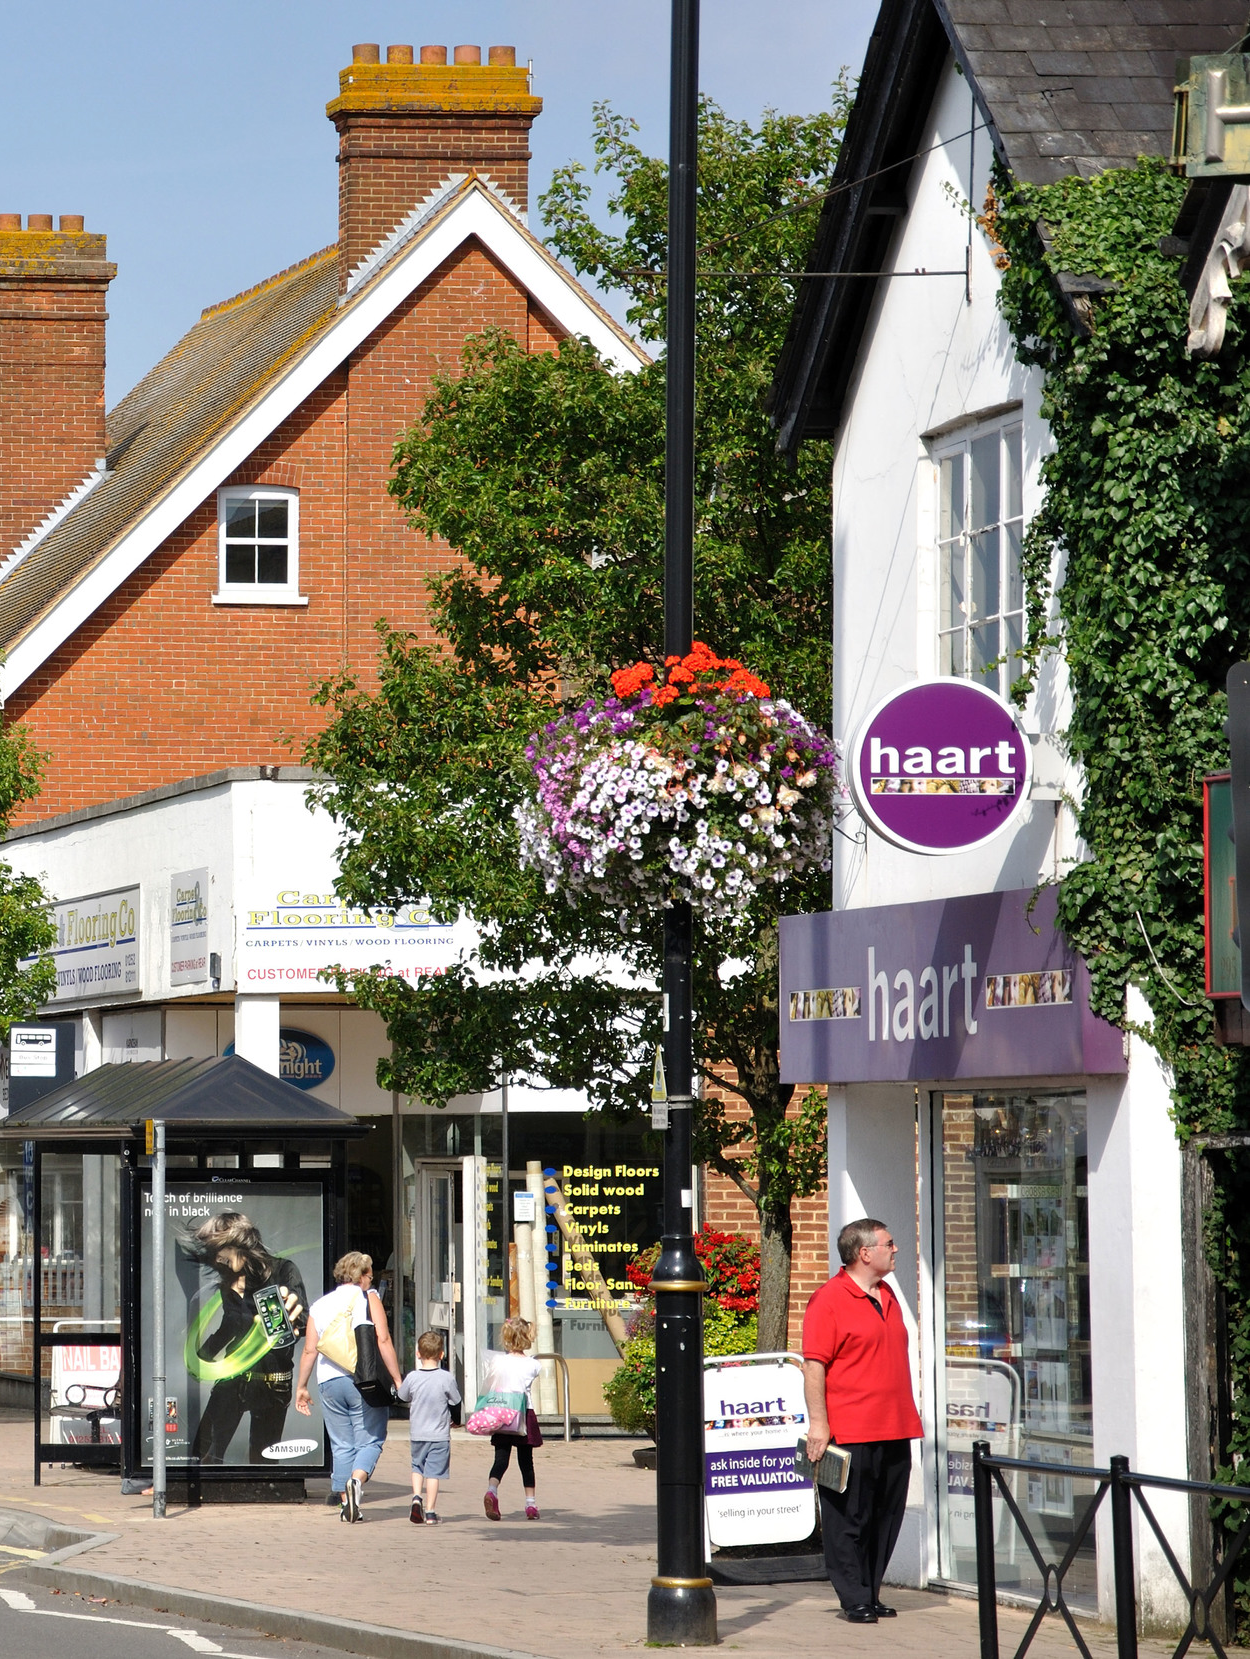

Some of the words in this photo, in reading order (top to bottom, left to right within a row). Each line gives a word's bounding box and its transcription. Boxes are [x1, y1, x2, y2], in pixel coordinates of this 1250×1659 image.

[870, 737, 1016, 774] haart
[67, 903, 117, 948] Flooring
[118, 900, 135, 937] Co
[248, 910, 394, 928] Flooring
[94, 961, 122, 982] FLOORING
[398, 968, 410, 978] at
[868, 944, 977, 1042] haart
[562, 1165, 611, 1181] Design
[615, 1165, 660, 1178] Floors
[144, 1192, 175, 1203] Toch
[179, 1192, 191, 1203] of
[193, 1192, 243, 1203] brilliance
[563, 1183, 599, 1197] Solid
[602, 1183, 645, 1197] wood
[169, 1206, 179, 1216] in
[182, 1206, 210, 1216] black
[564, 1203, 621, 1218] Carpets
[564, 1222, 610, 1237] Vinyls
[564, 1240, 639, 1253] Laminates
[564, 1260, 600, 1273] Beds
[564, 1278, 602, 1291] Floor
[564, 1298, 631, 1310] Furniture
[62, 1346, 96, 1370] NAIL
[100, 1346, 121, 1370] BA
[720, 1397, 787, 1416] haart
[269, 1445, 312, 1453] SAMSUNG
[710, 1458, 728, 1471] ask
[729, 1456, 760, 1470] inside
[761, 1455, 777, 1468] for
[779, 1456, 795, 1469] you
[711, 1475, 739, 1488] FREE
[740, 1471, 805, 1486] VALUATION
[747, 1508, 755, 1516] in
[756, 1508, 775, 1517] your
